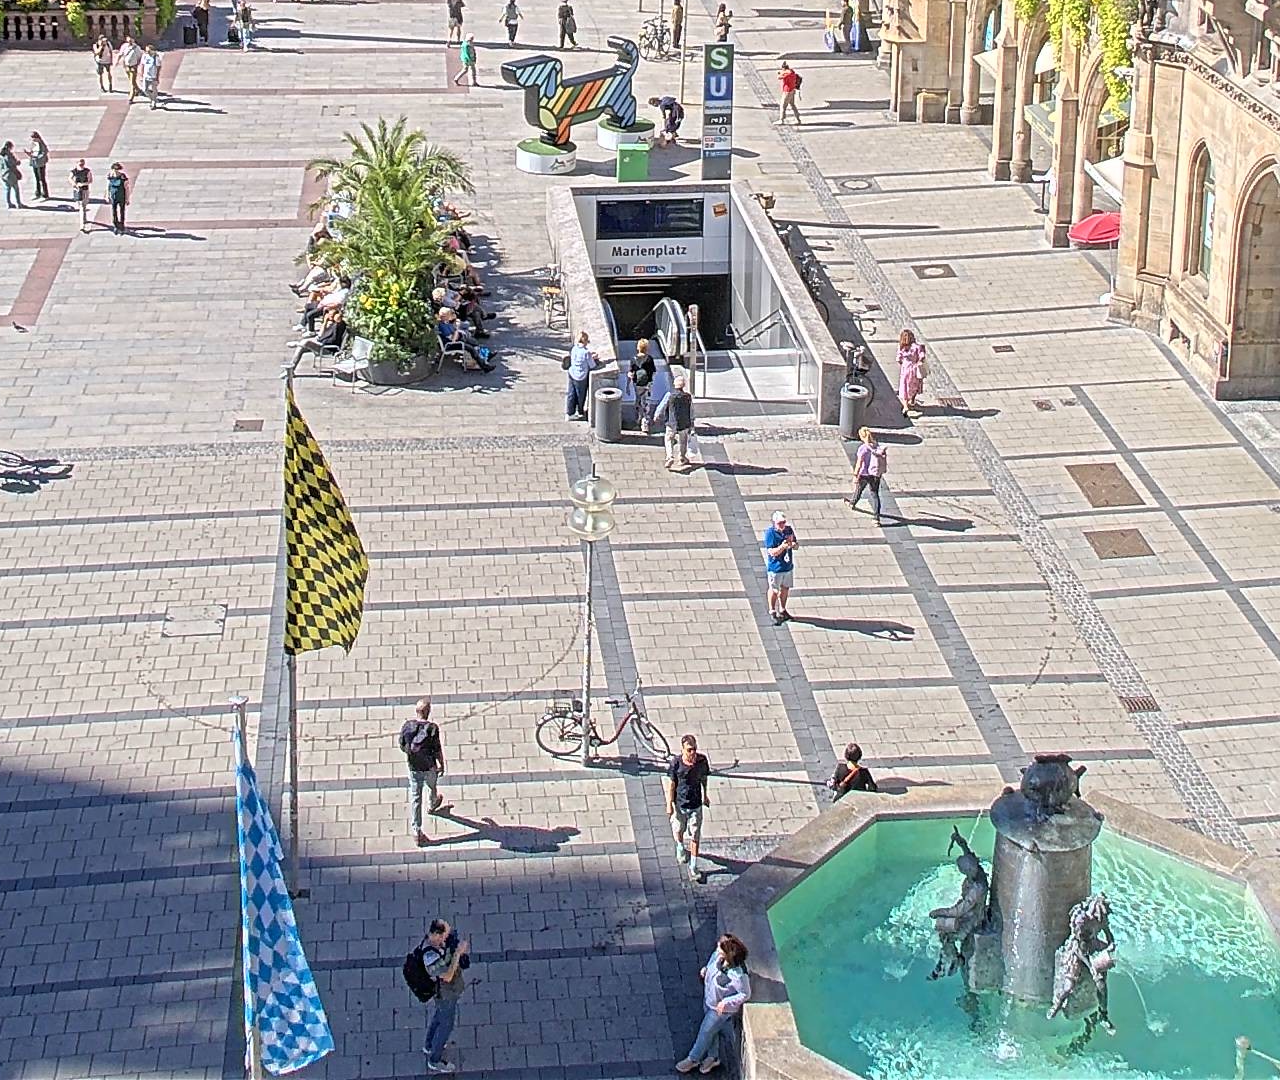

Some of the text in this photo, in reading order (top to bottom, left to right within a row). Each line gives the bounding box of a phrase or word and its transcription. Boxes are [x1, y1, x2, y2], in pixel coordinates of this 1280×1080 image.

[710, 47, 729, 70] S
[710, 76, 727, 97] U
[612, 244, 687, 258] Marienplatz
